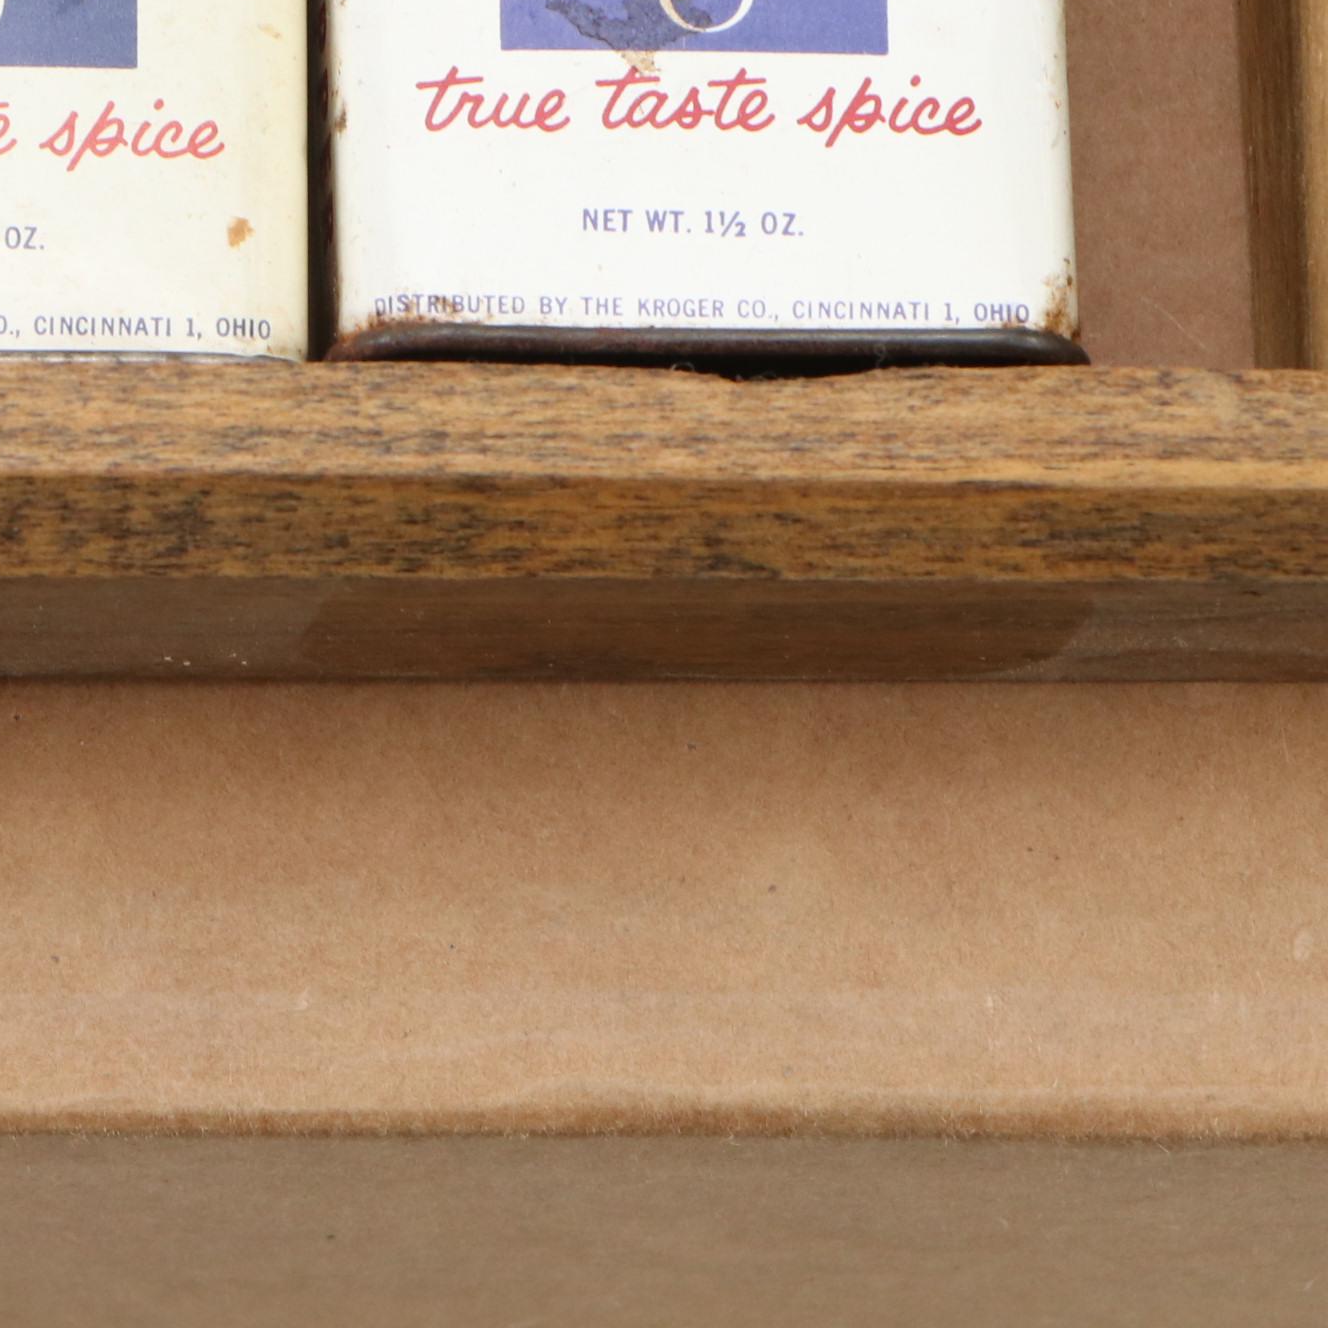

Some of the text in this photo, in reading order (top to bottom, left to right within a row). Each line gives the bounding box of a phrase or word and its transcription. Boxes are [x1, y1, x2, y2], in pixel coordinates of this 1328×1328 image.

[416, 66, 982, 148] true taste spice
[39, 99, 225, 172] spice
[583, 209, 632, 232] NET
[646, 210, 691, 233] WT.
[761, 212, 803, 236] OZ.
[5, 227, 44, 250] OZ.
[375, 295, 1030, 324] DISTRIBUTED BY THE KROGER CO., CINCINNATI 1, OHIO
[34, 316, 170, 337] CINCINNATI
[187, 318, 202, 341] 1,
[217, 318, 271, 341] OHIO
